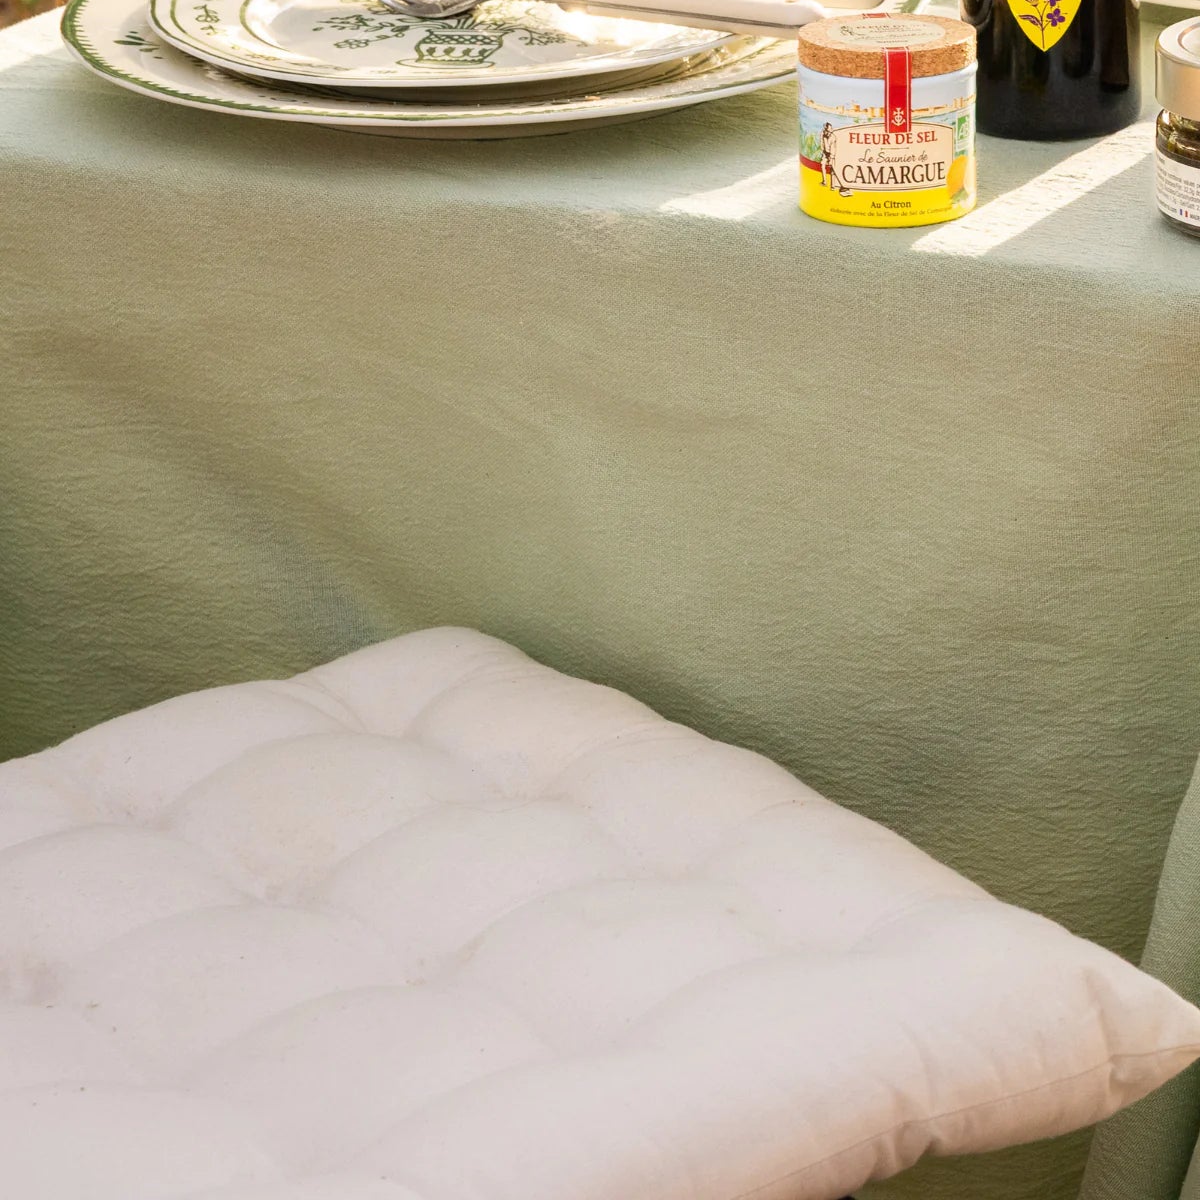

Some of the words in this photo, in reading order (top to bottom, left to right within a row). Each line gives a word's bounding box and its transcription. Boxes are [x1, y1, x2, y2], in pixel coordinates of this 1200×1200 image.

[849, 132, 890, 145] FLEUR
[895, 132, 913, 145] DE
[916, 130, 938, 144] SEL
[858, 148, 874, 164] Le
[876, 151, 916, 164] Saunier
[918, 150, 928, 163] de
[841, 161, 946, 185] CAMARGUE
[871, 201, 881, 209] Au
[883, 200, 912, 209] Citron
